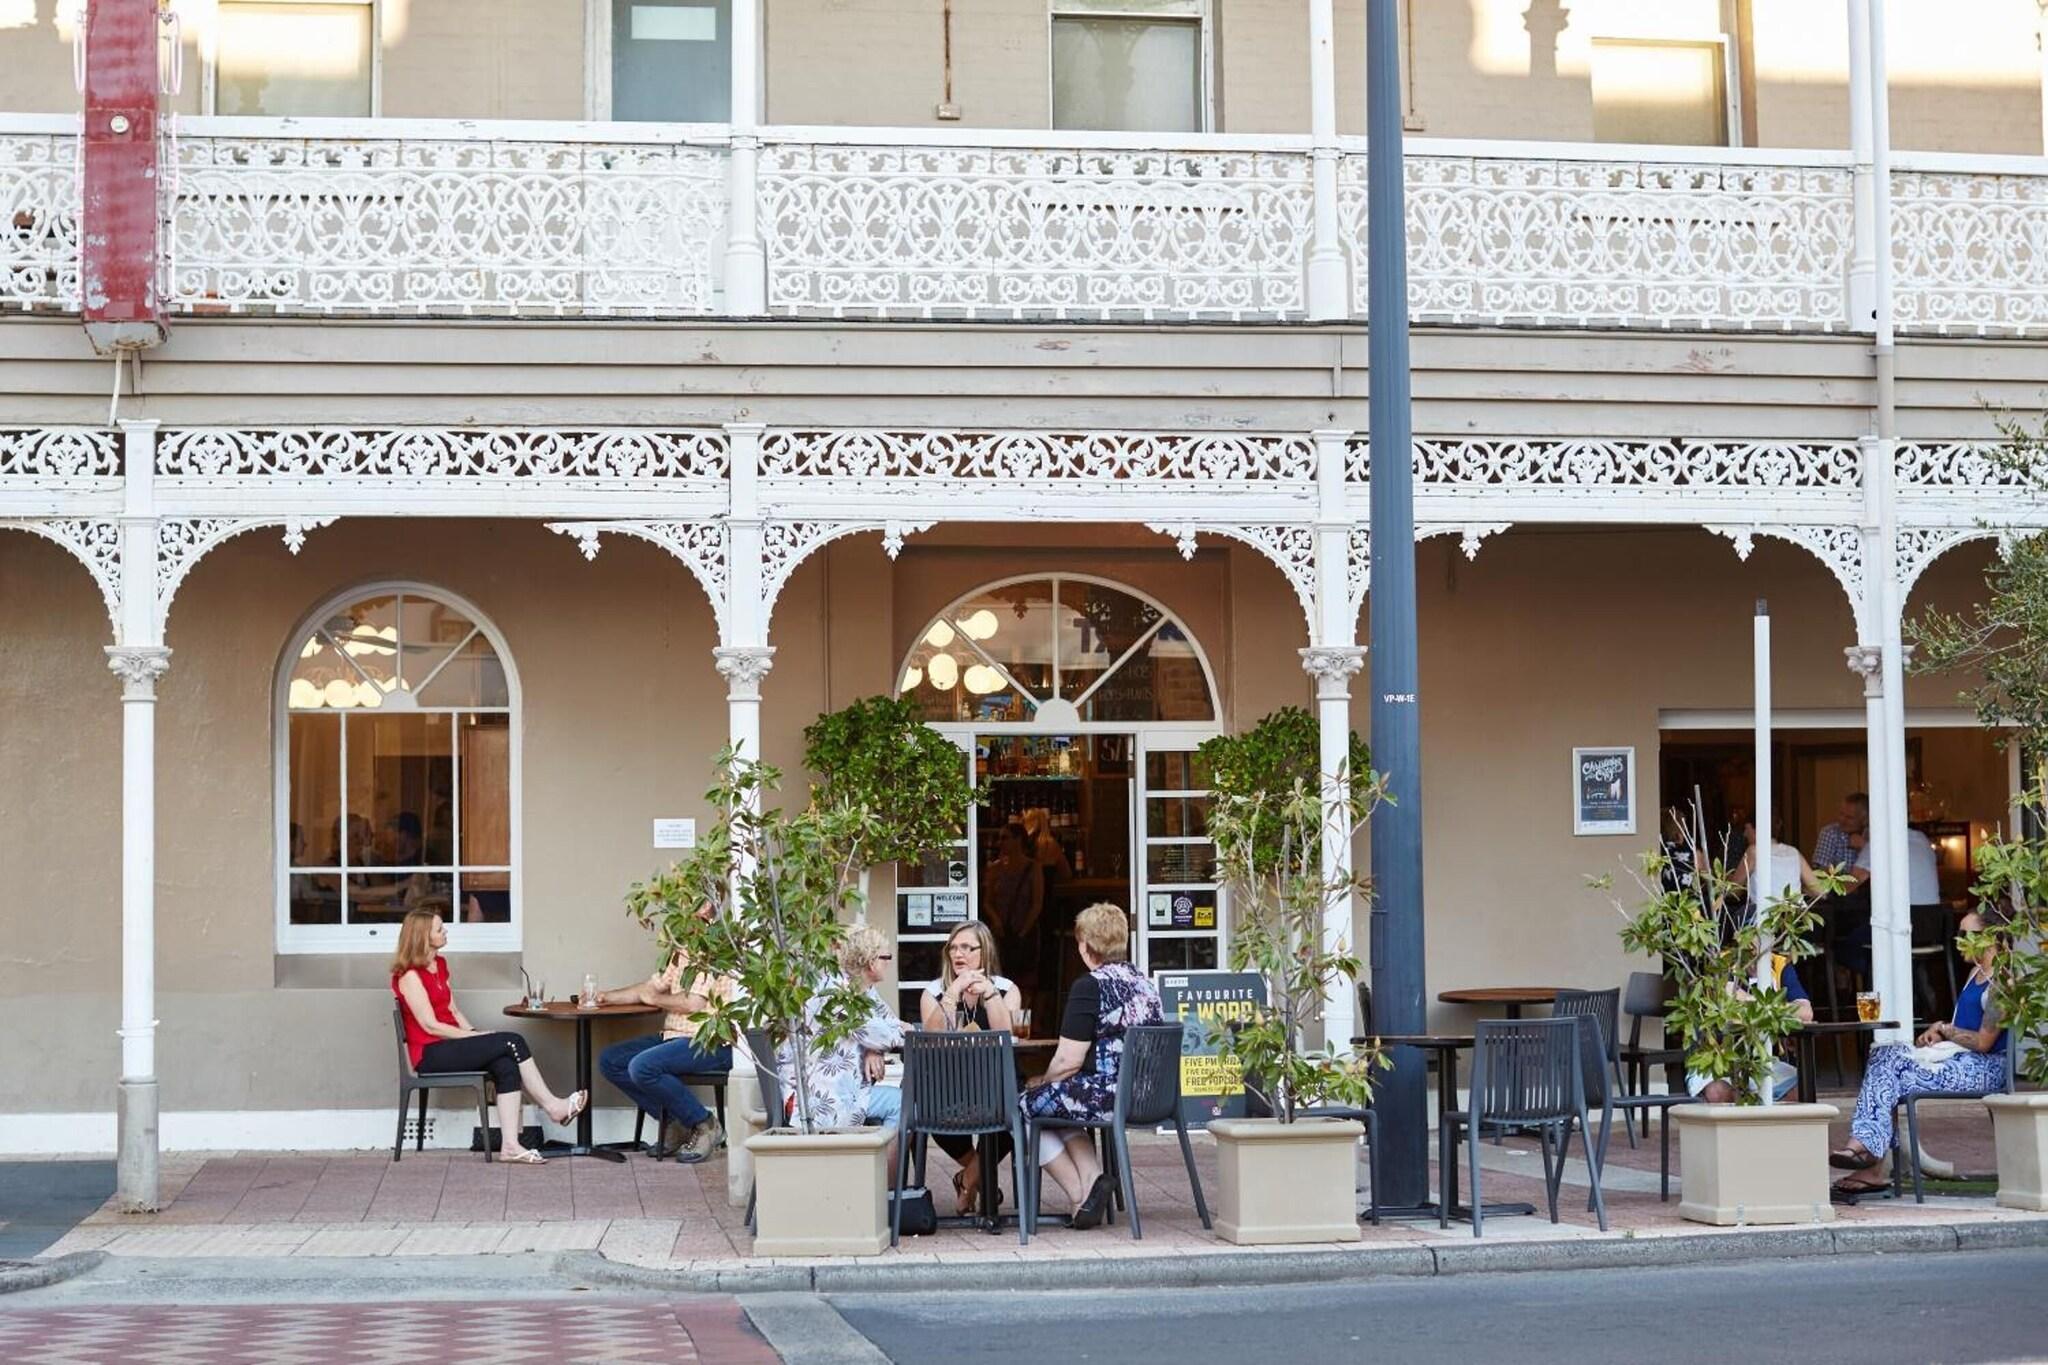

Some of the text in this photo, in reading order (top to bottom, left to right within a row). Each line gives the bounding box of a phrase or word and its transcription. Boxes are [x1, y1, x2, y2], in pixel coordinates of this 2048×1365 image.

[1177, 988, 1253, 1001] FAVOURITE
[1178, 1000, 1253, 1024] F WORD
[1184, 1057, 1203, 1067] FIVE
[1205, 1057, 1217, 1066] PM
